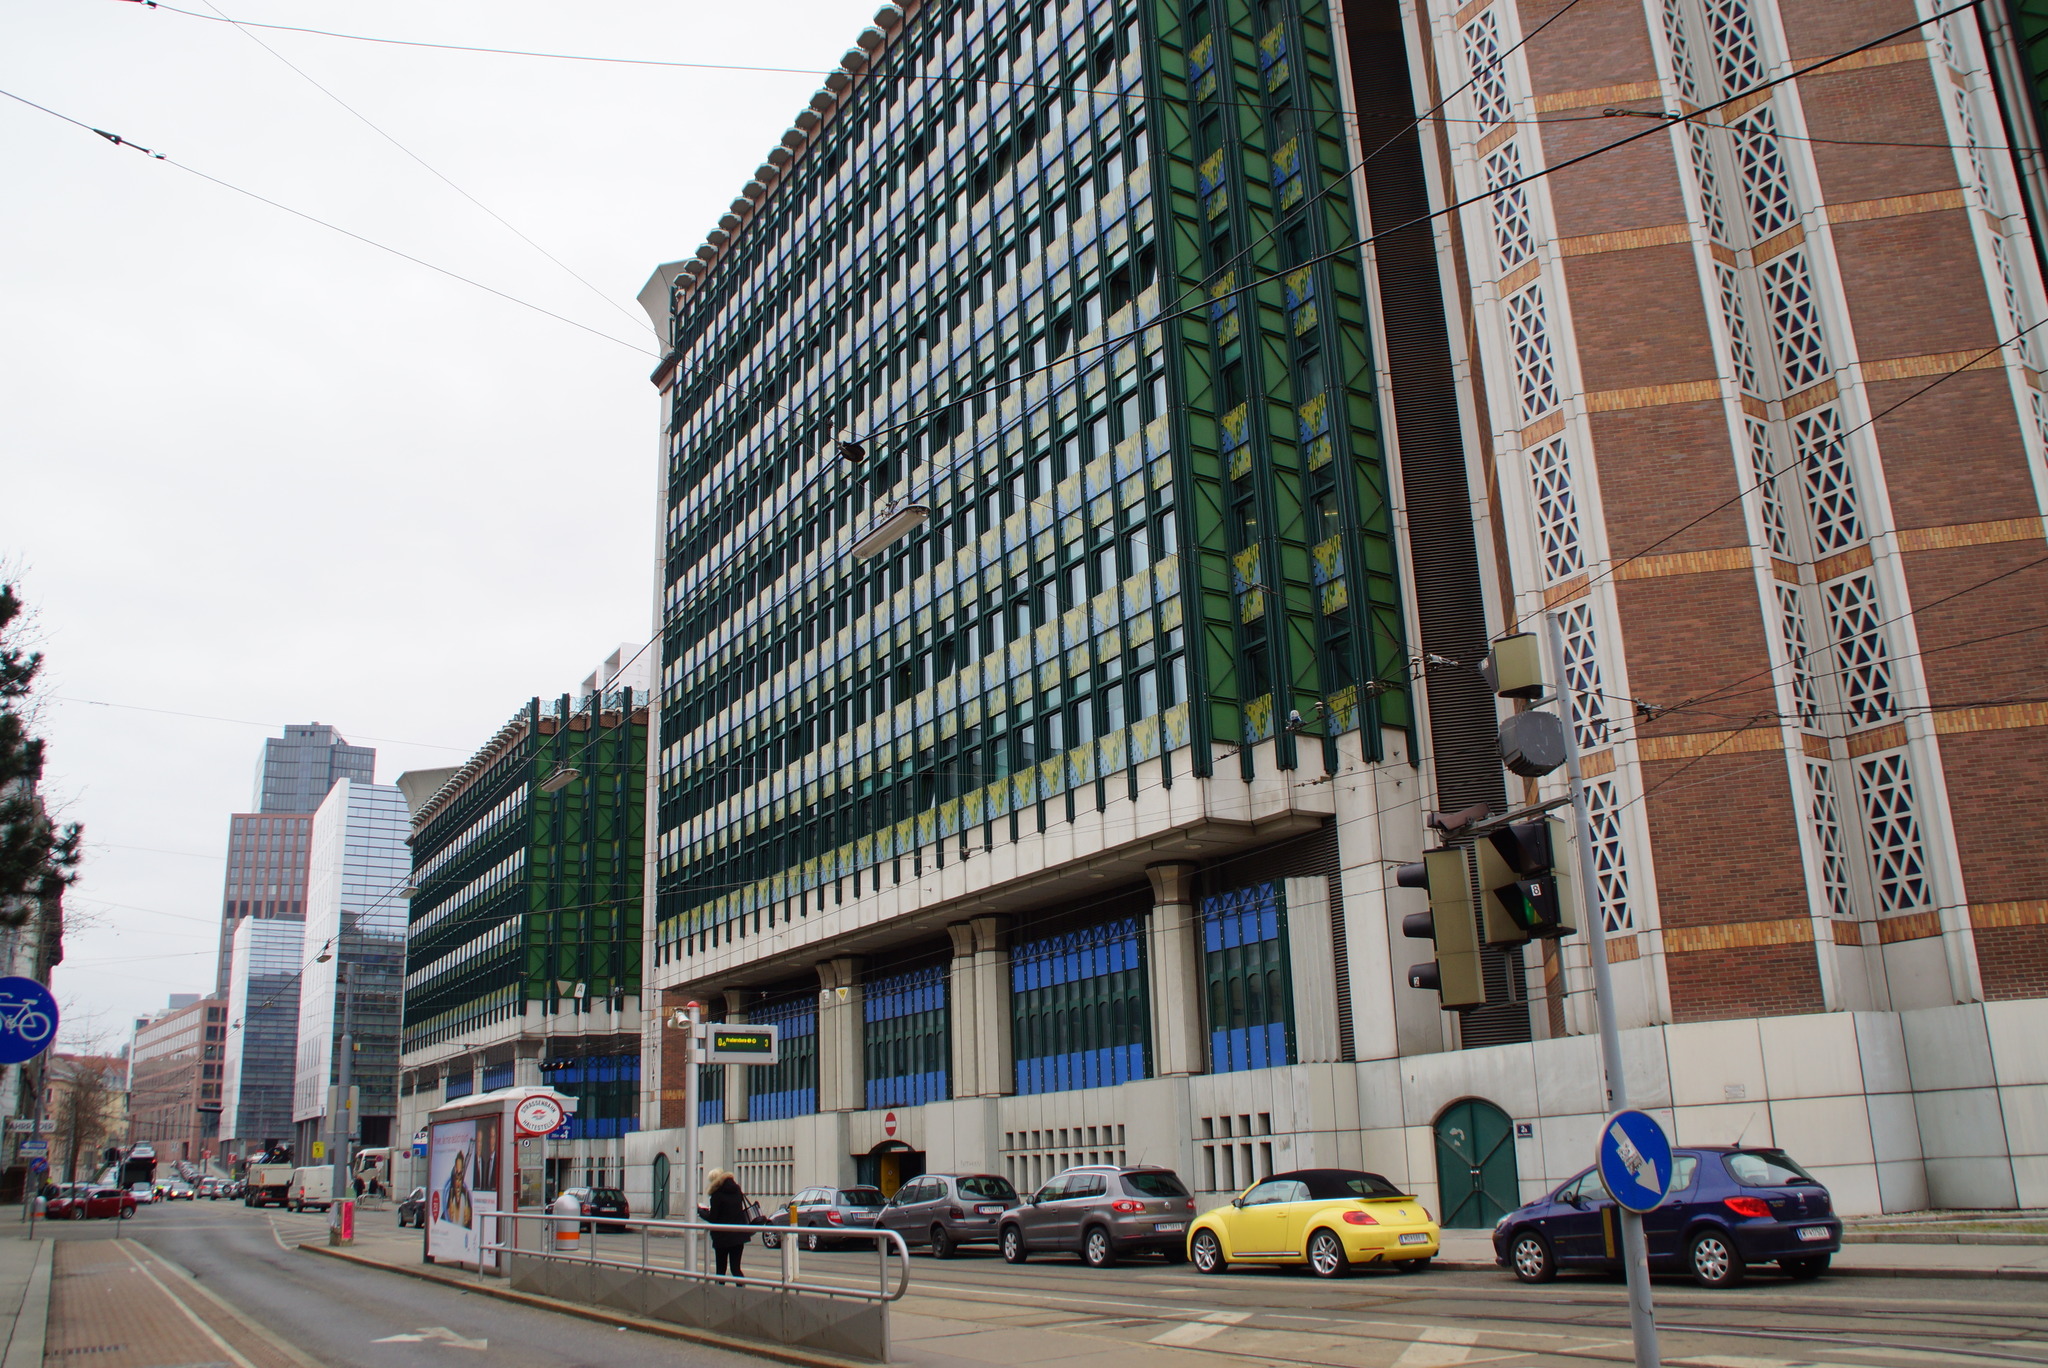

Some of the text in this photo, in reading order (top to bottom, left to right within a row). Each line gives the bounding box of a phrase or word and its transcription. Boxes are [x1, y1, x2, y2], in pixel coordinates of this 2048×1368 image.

[1533, 885, 1539, 895] 8
[577, 984, 583, 993] A
[520, 1100, 556, 1113] STRASSENBAHN
[522, 1119, 556, 1131] HALTESTELLE
